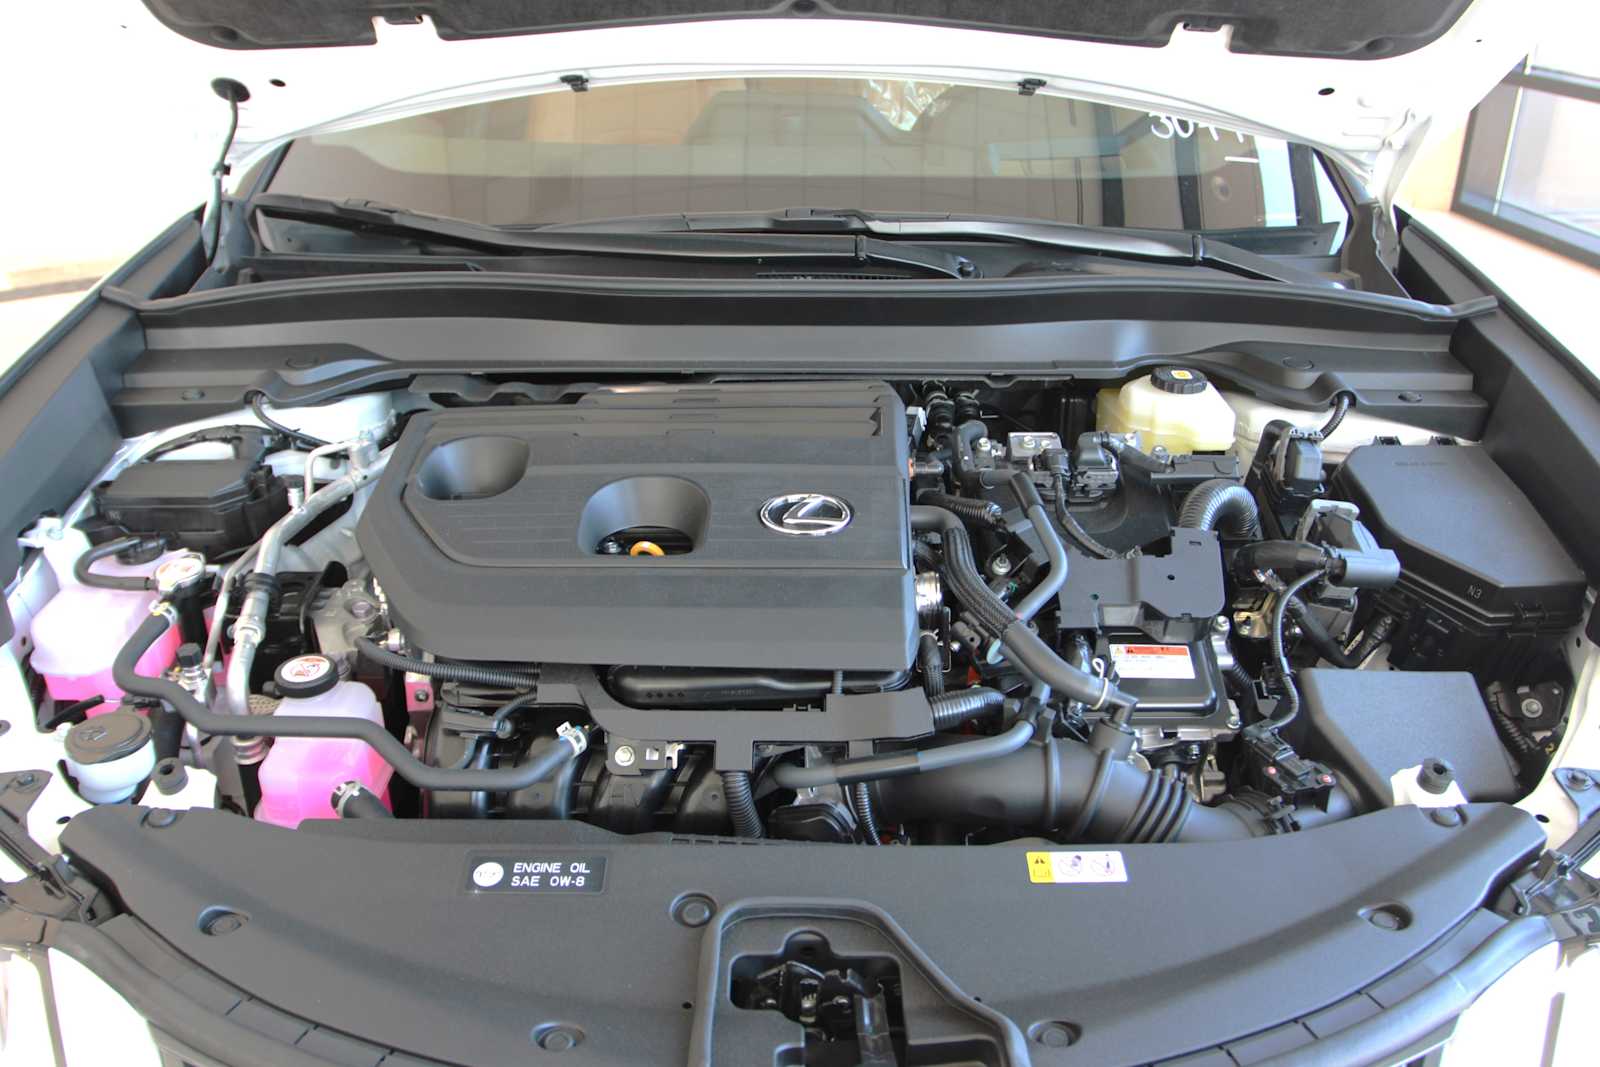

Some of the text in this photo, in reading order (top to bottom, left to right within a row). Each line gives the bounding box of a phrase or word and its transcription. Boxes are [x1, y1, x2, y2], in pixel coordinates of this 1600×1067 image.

[513, 862, 562, 874] ENGINE
[569, 862, 591, 874] OIL
[510, 875, 541, 887] SAE
